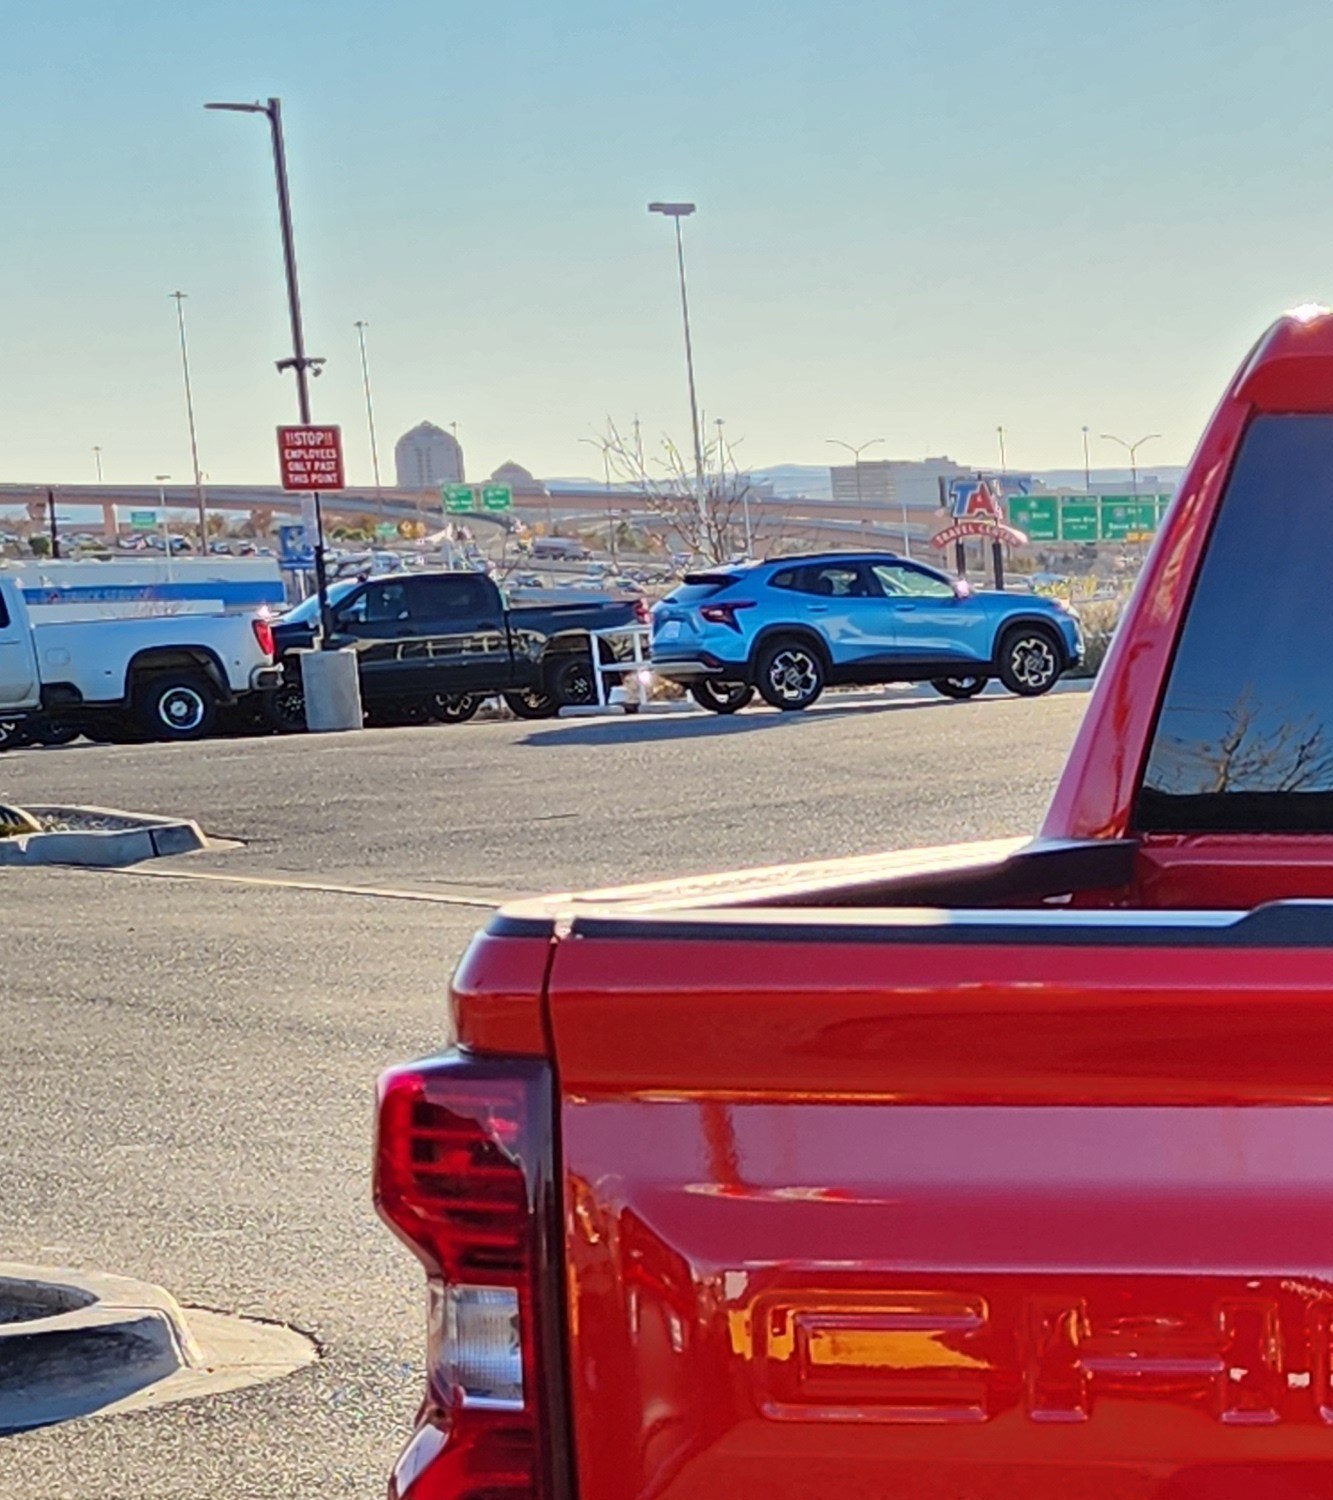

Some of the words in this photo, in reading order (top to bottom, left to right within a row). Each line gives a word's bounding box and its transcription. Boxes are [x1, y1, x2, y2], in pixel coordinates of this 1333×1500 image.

[284, 448, 337, 460] EMPLOYEES
[287, 461, 312, 472] ONLY
[313, 461, 337, 472] PAST
[288, 473, 309, 484] THIS
[310, 472, 338, 484] POINT
[951, 480, 998, 518] TA
[934, 523, 975, 546] TRAVEL
